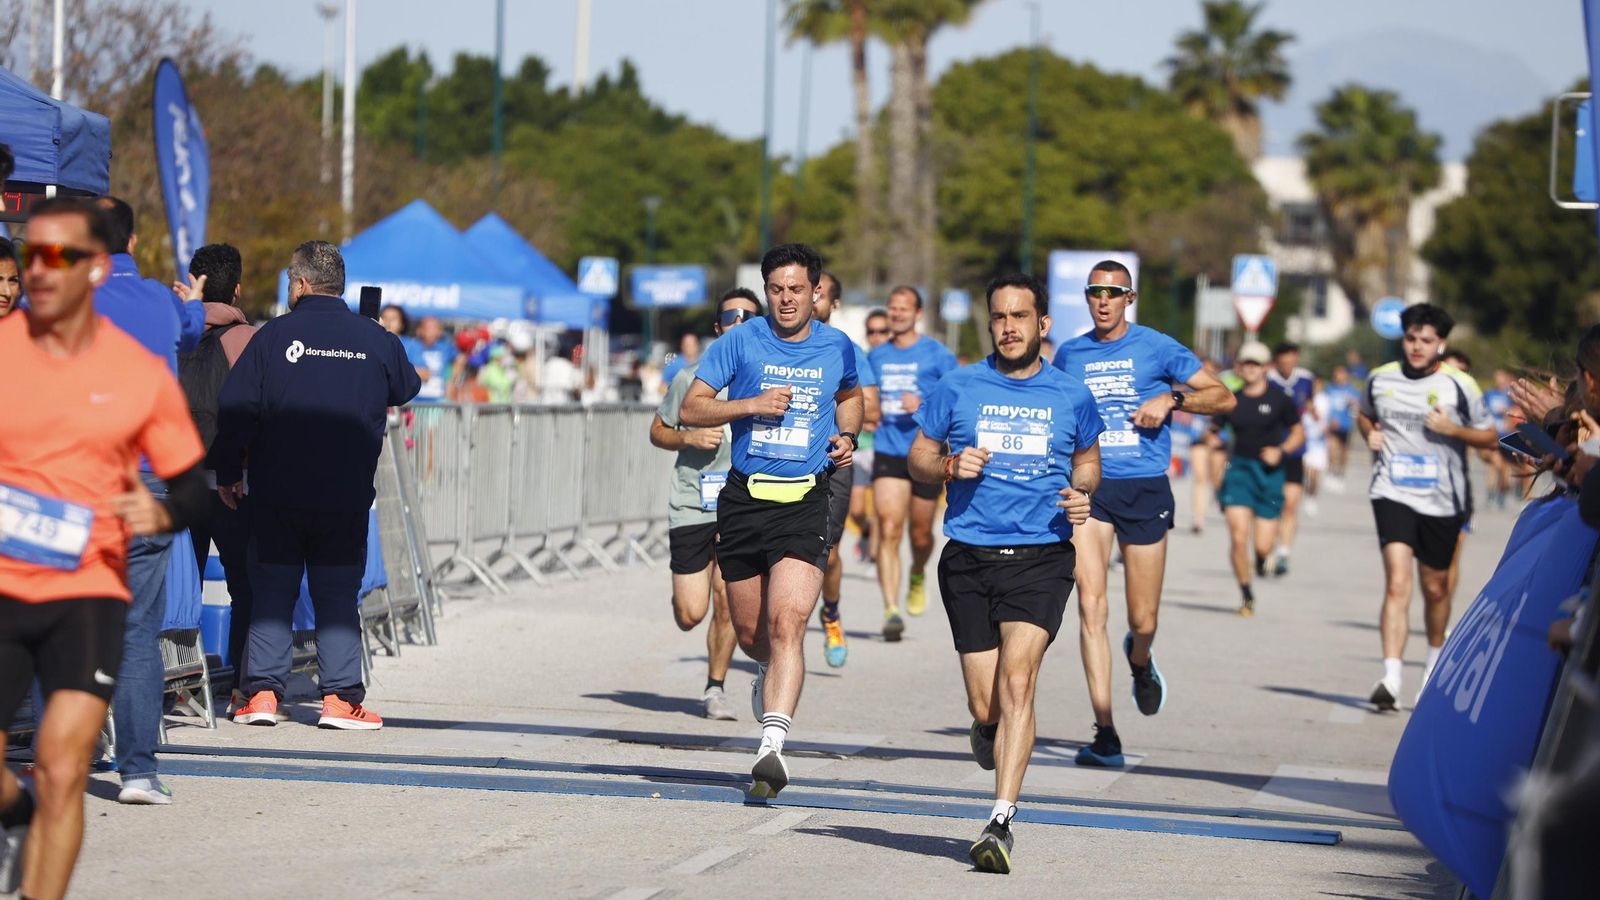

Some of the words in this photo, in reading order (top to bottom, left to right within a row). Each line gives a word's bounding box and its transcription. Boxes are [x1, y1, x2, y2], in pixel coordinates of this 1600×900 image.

[305, 347, 366, 360] dorsalchip.es
[764, 365, 822, 378] mayoral
[1085, 359, 1132, 371] mayoral
[982, 404, 1052, 421] mayoral
[765, 426, 792, 442] 317
[1100, 431, 1125, 445] 452
[1002, 435, 1023, 451] 86
